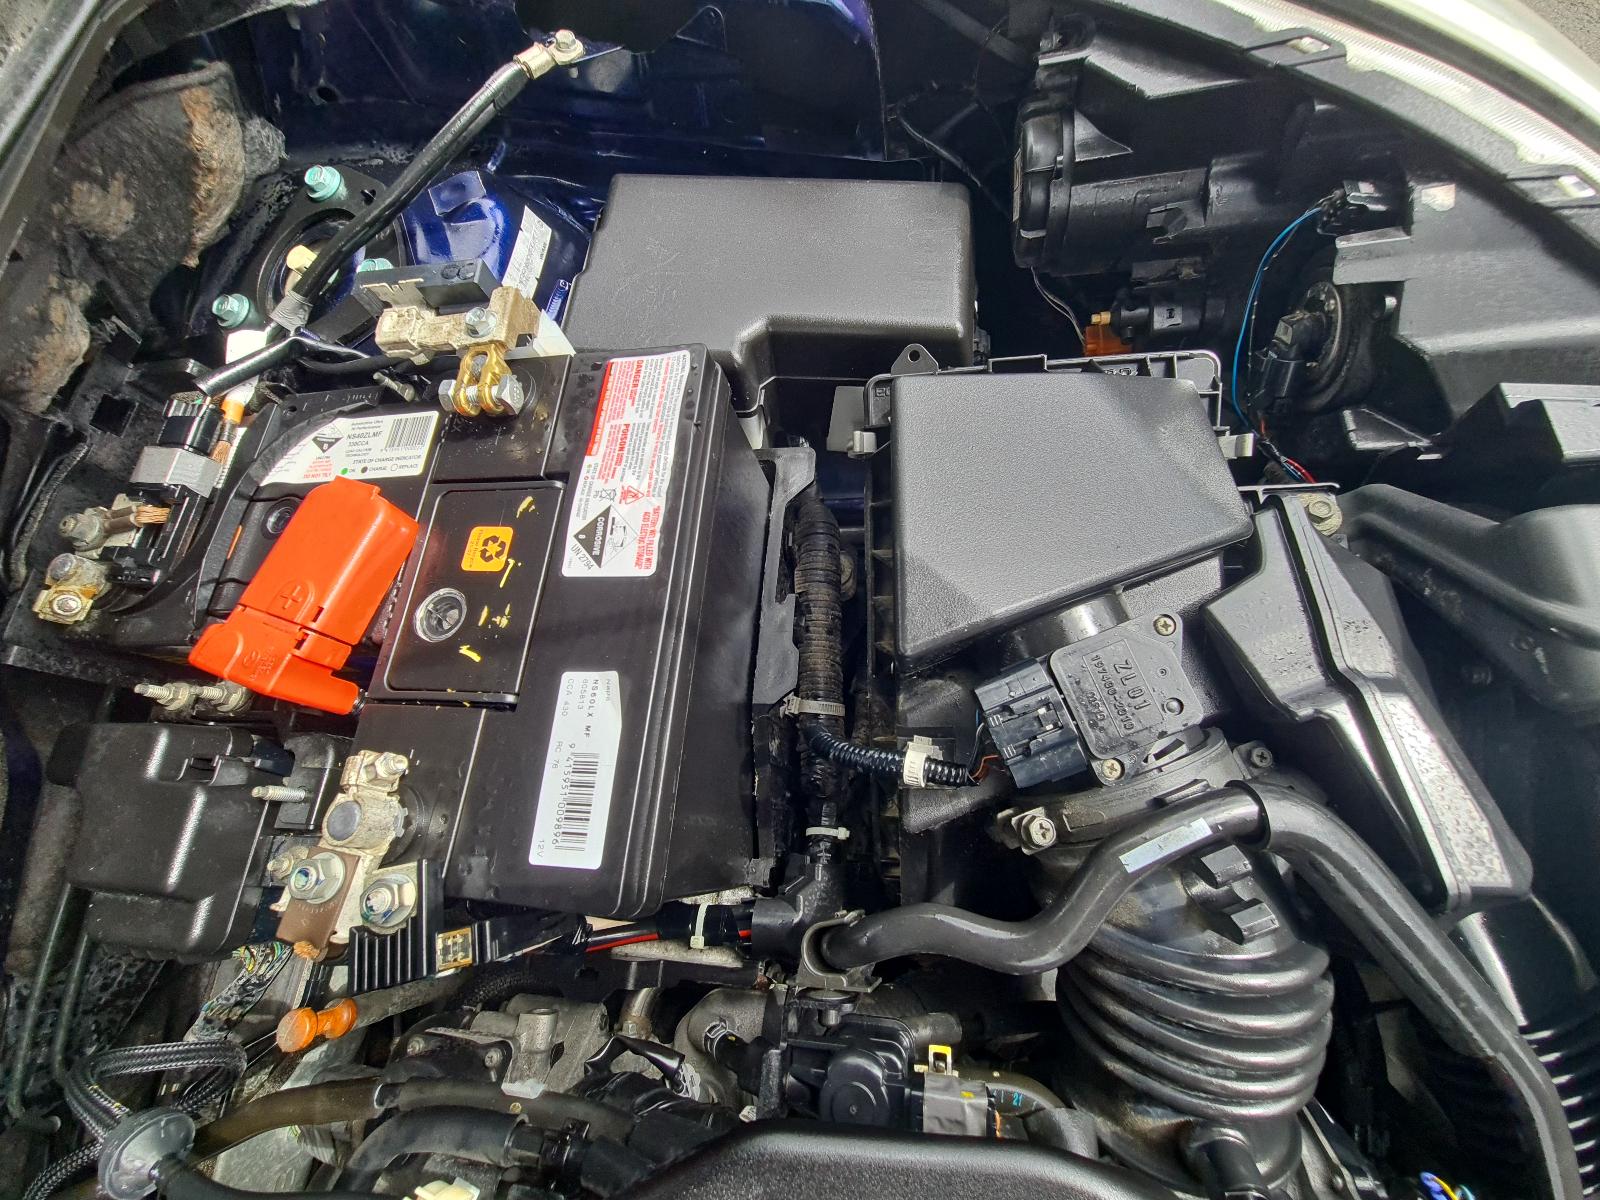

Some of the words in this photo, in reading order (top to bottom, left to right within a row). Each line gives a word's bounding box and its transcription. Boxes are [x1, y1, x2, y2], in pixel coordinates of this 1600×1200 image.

[631, 360, 644, 389] DANGER
[618, 423, 631, 452] POISON
[592, 516, 605, 556] CORROSIVE
[571, 543, 582, 556] UN
[580, 553, 594, 570] 2794
[566, 679, 575, 696] CCA
[1113, 659, 1151, 710] ZL01
[561, 701, 570, 717] 430
[584, 725, 591, 738] MF
[555, 741, 563, 753] RC
[560, 756, 574, 796] 415951
[552, 802, 566, 844] 009896
[537, 840, 545, 857] 12V
